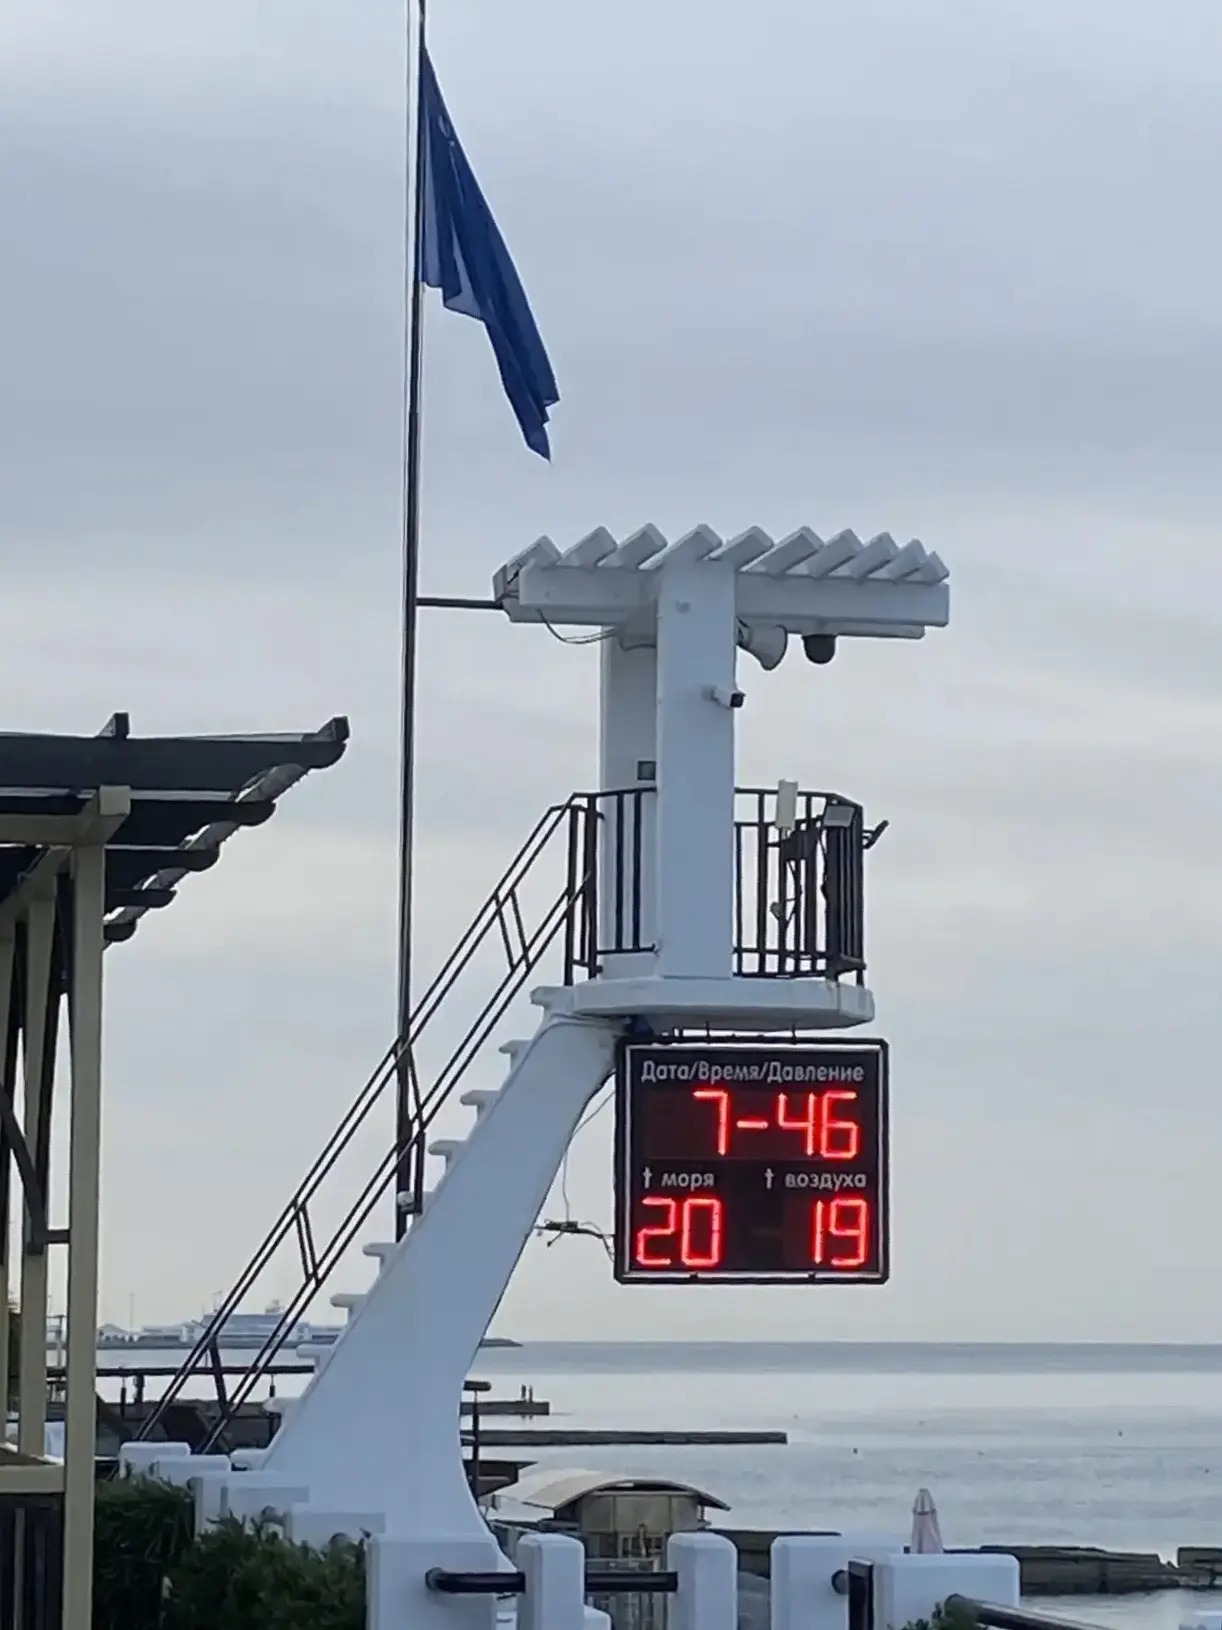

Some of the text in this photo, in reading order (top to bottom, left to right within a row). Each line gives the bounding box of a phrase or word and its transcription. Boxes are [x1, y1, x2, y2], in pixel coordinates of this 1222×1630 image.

[641, 1060, 865, 1085] Дата/Время/Давление
[661, 1172, 715, 1192] моря
[785, 1172, 867, 1193] воздуха
[636, 1198, 721, 1266] 20
[813, 1198, 868, 1266] 19
